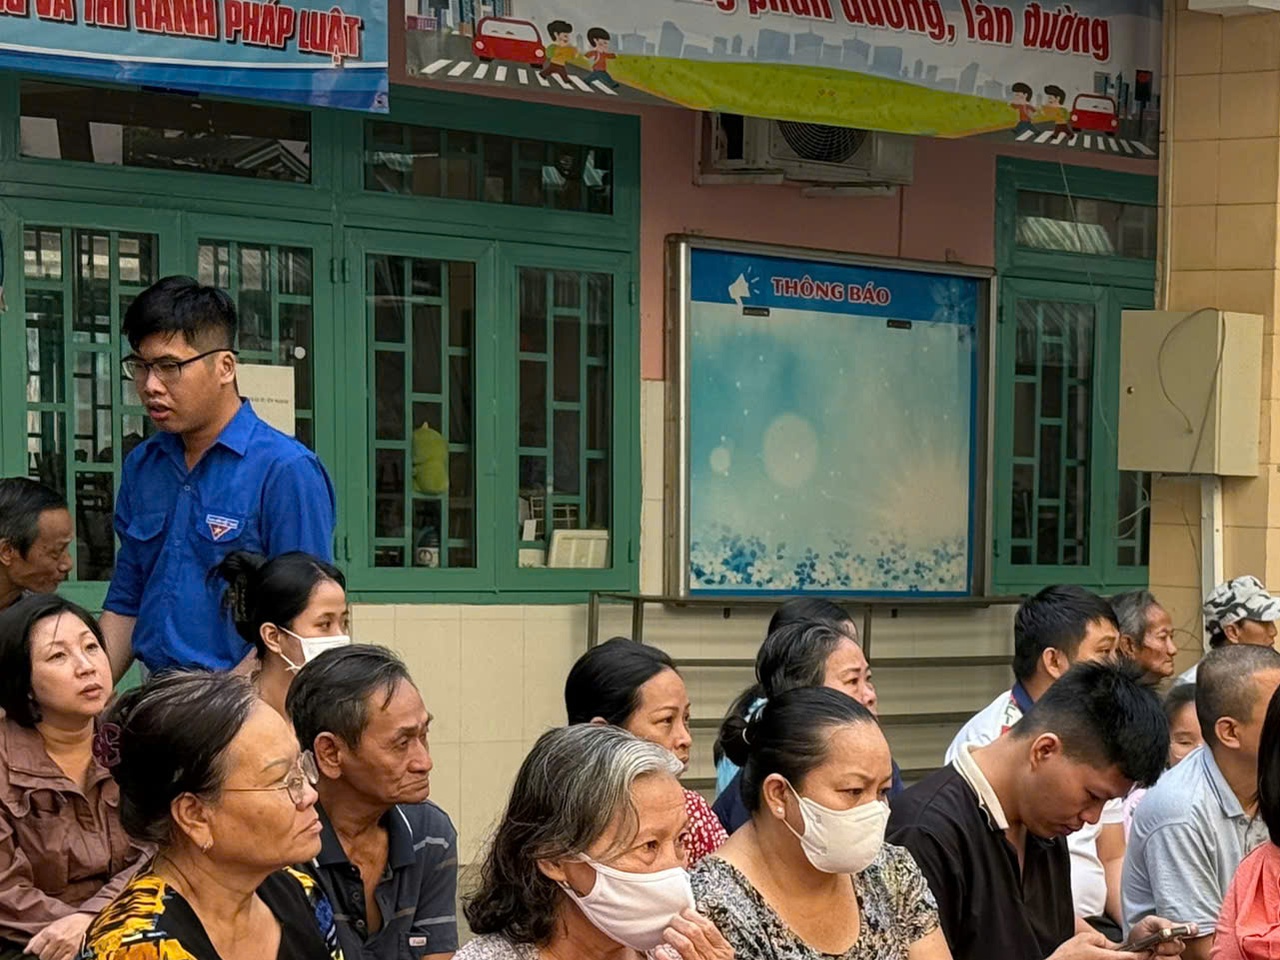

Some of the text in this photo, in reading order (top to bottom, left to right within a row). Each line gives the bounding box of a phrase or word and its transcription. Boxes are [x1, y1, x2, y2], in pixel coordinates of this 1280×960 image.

[224, 0, 294, 47] PHÁP
[298, 5, 361, 65] LUẬT
[1023, 2, 1110, 62] đường
[771, 274, 892, 306] THÔNG BÁO
